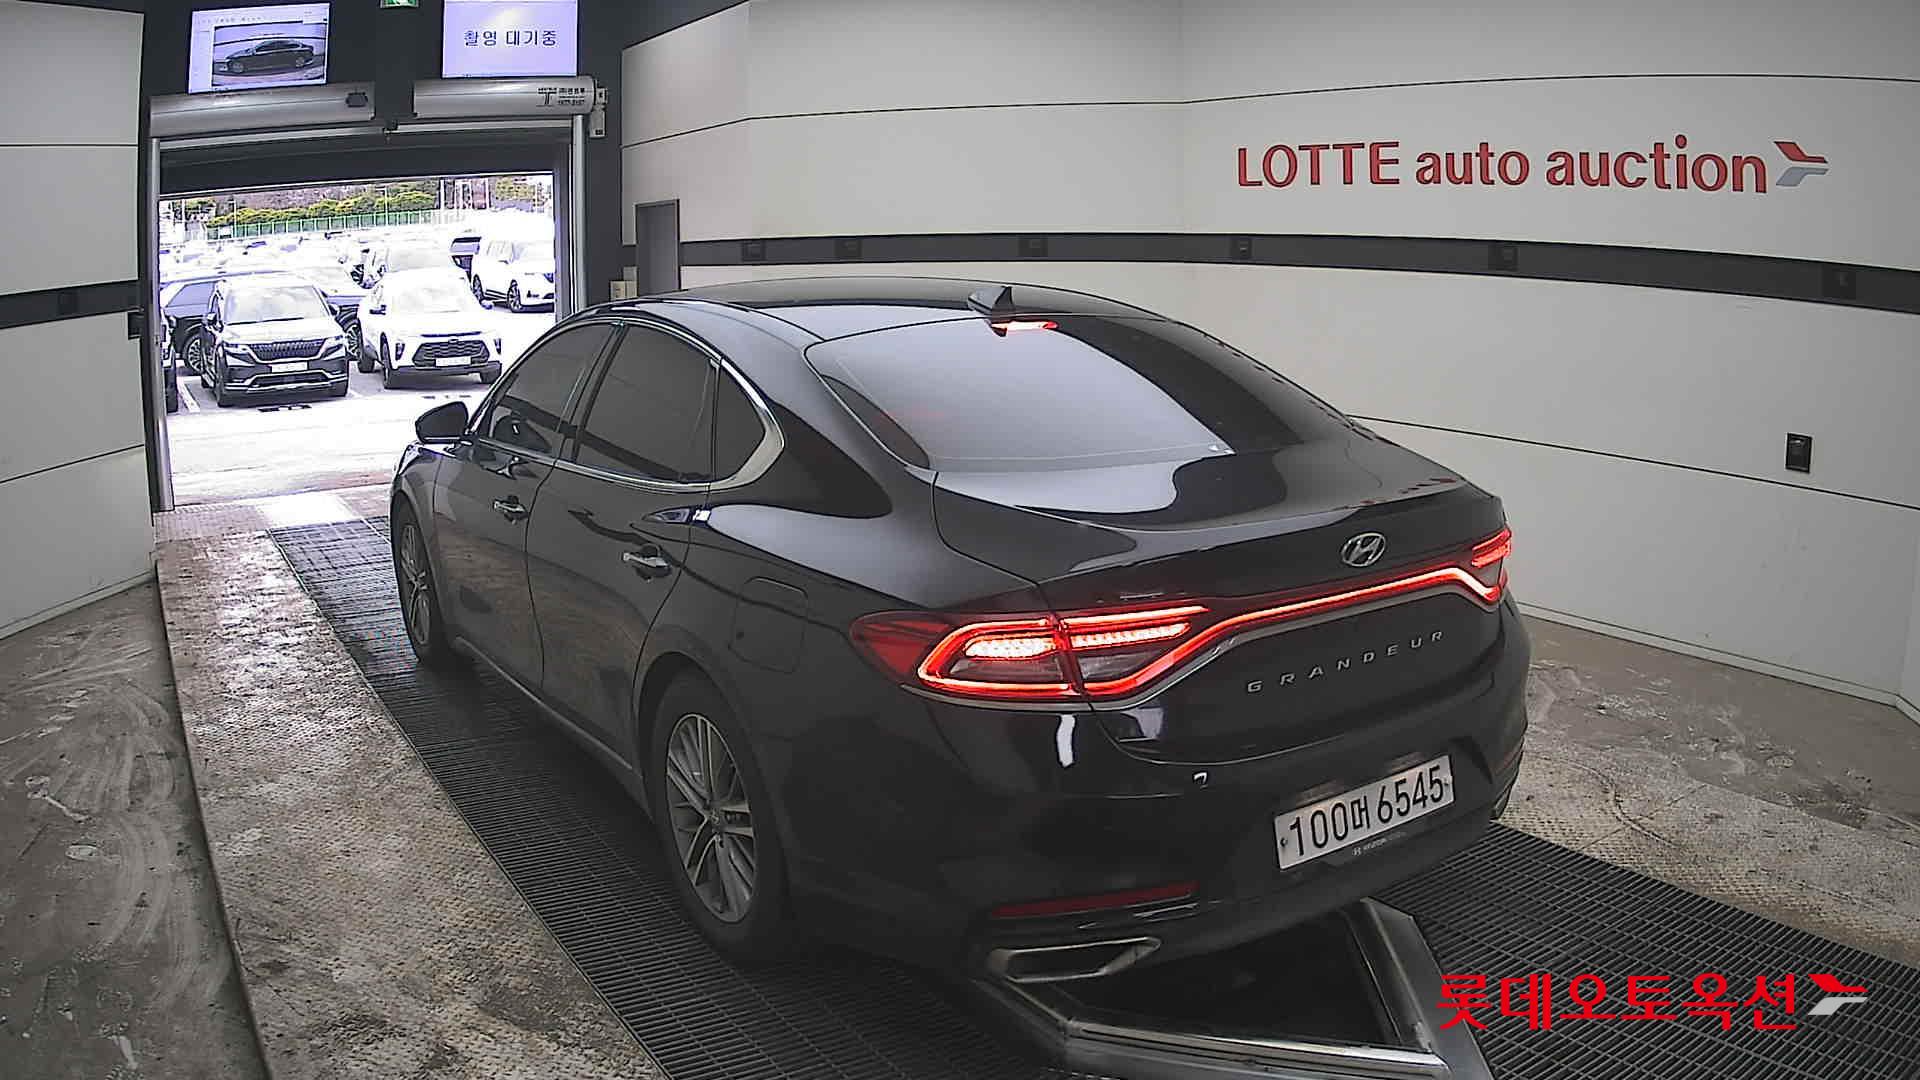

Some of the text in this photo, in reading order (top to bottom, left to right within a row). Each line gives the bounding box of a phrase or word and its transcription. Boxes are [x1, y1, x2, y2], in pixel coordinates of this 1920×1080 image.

[505, 29, 557, 47] 대기중
[1237, 133, 1768, 194] LOTTE auto auction
[1246, 630, 1443, 693] GRANDEUR
